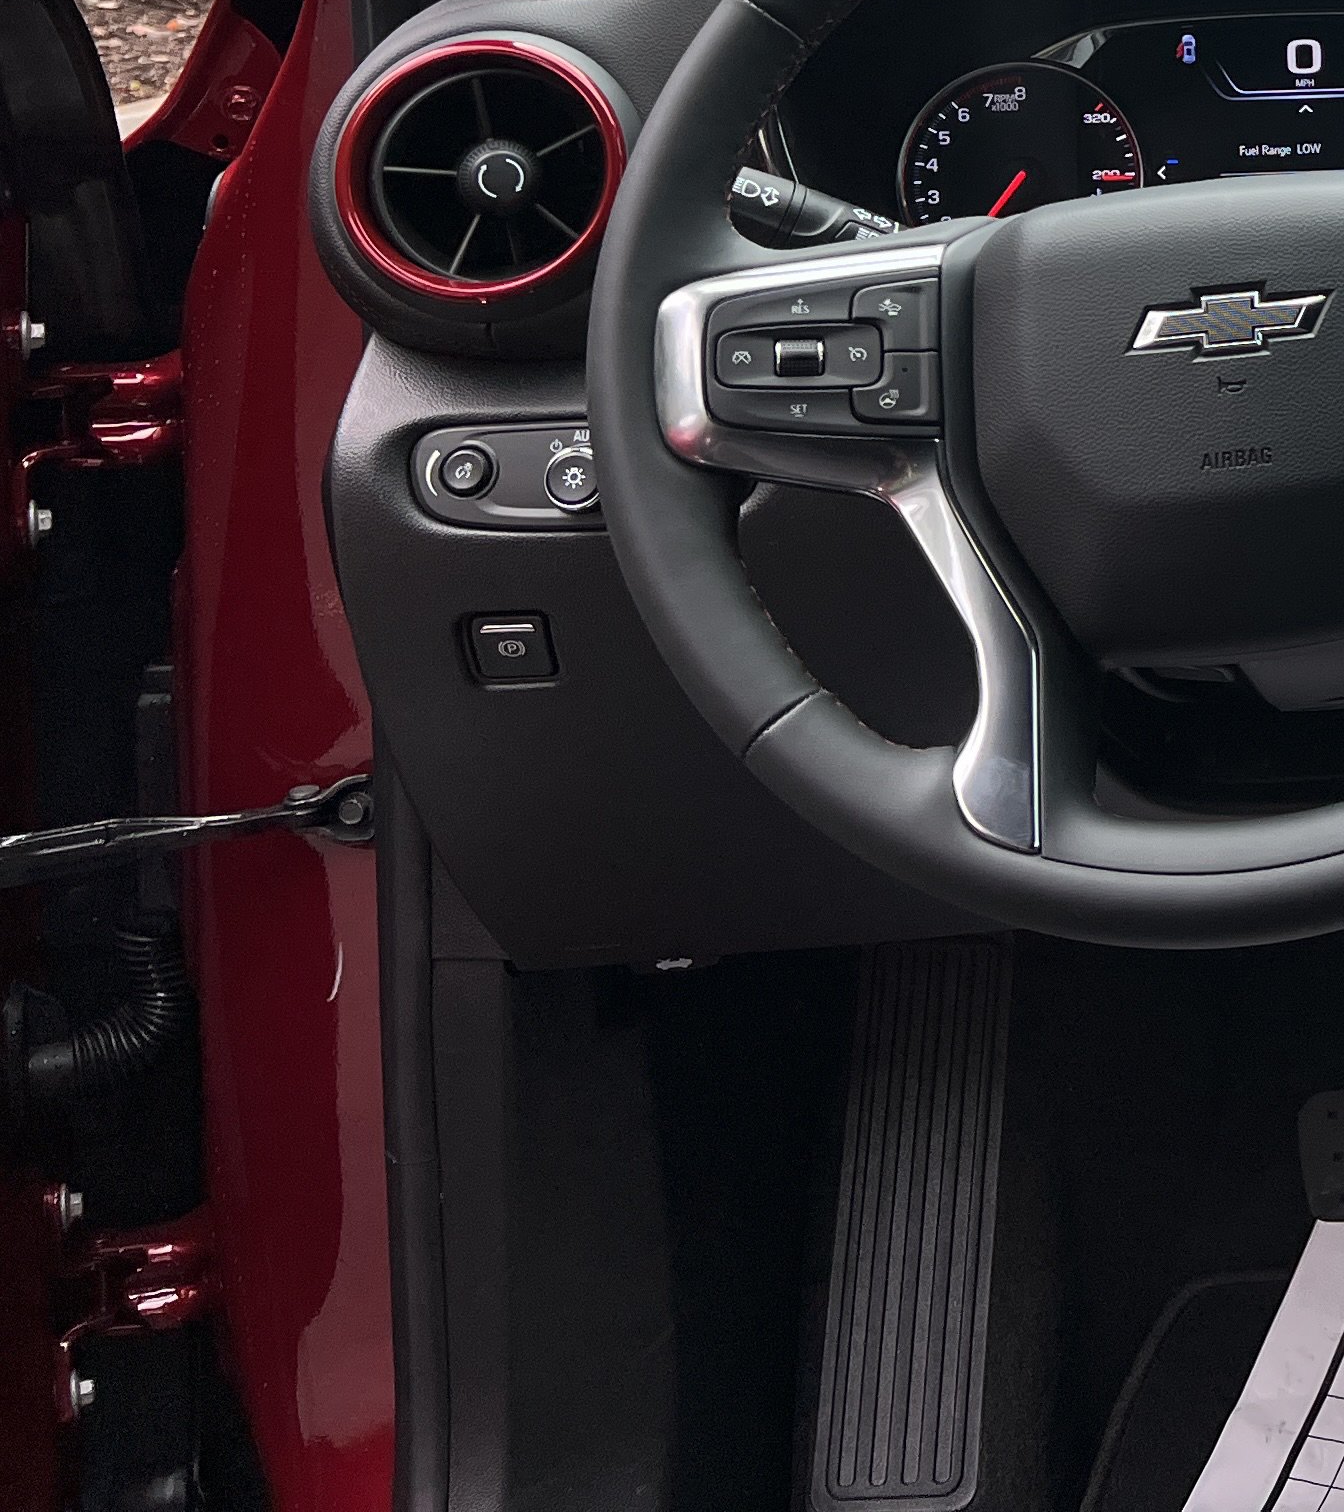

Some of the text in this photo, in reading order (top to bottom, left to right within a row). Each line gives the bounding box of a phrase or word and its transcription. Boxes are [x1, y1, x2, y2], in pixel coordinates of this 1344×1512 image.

[1286, 38, 1322, 74] 0
[1295, 78, 1315, 87] MPH
[982, 93, 994, 108] 7
[994, 94, 1015, 104] RPM
[1014, 86, 1026, 101] 8
[957, 108, 970, 122] 6
[1083, 112, 1111, 124] 320
[938, 131, 950, 145] 5
[1239, 143, 1322, 157] Fuel Range LOW
[926, 158, 939, 173] 4
[927, 190, 940, 205] 3
[791, 305, 810, 314] RES
[790, 404, 808, 414] SET
[1200, 445, 1273, 472] AIRBAG
